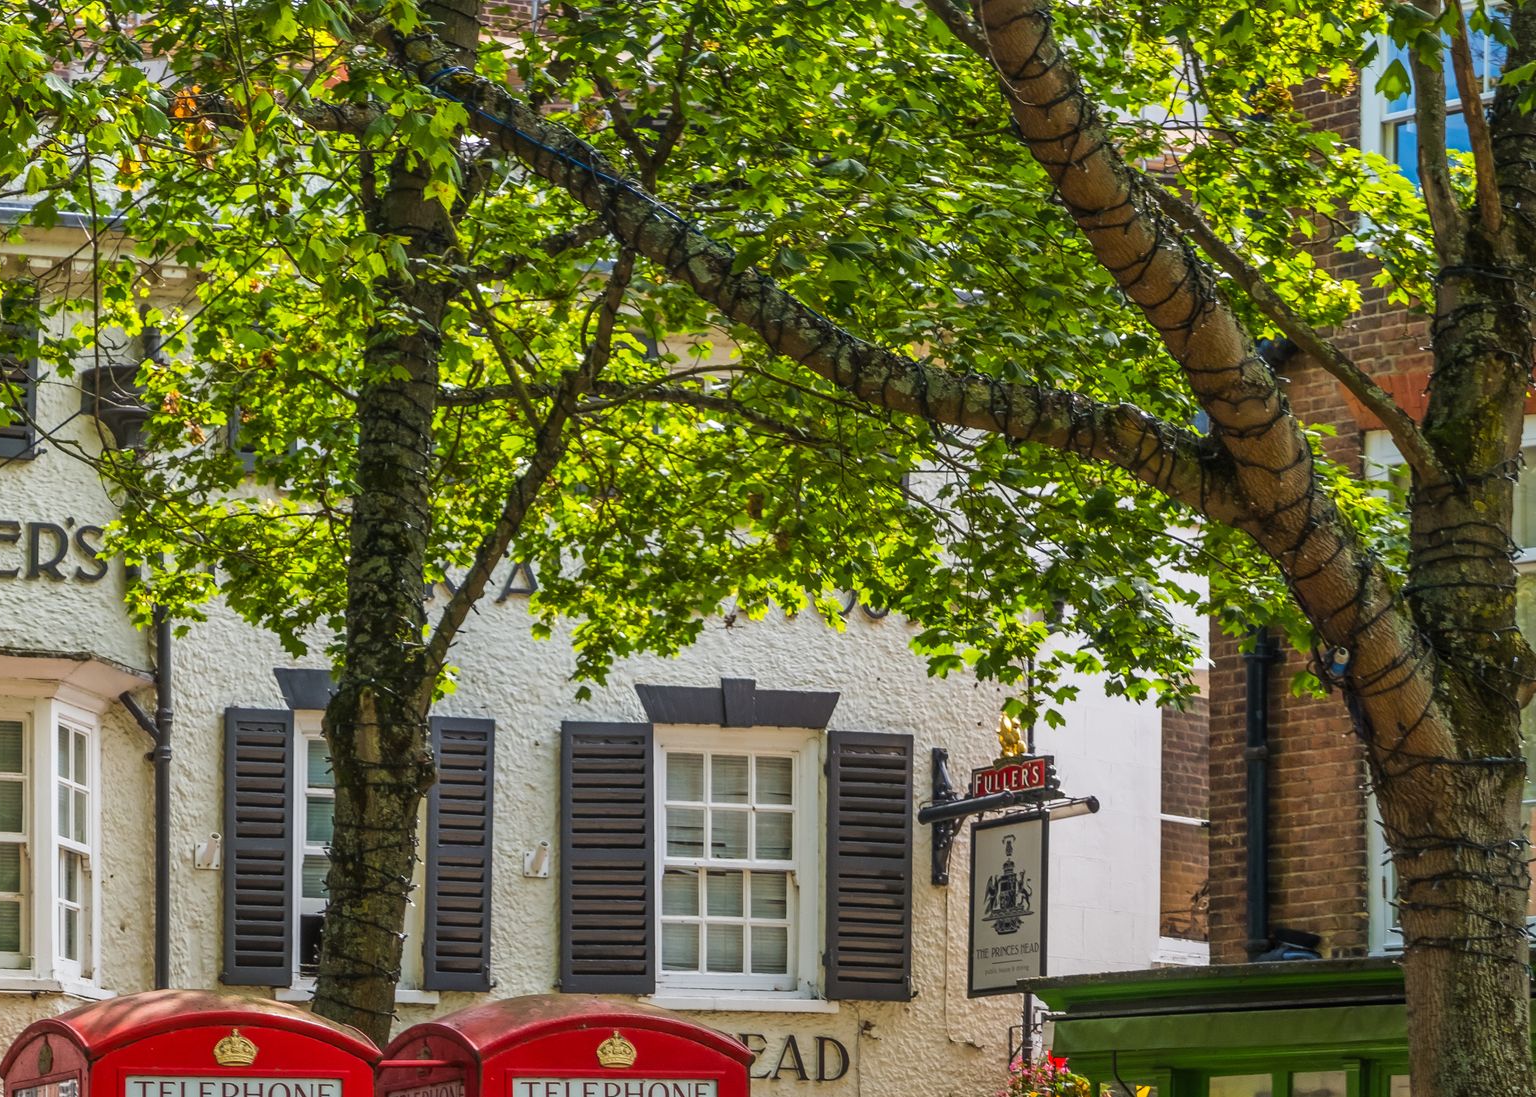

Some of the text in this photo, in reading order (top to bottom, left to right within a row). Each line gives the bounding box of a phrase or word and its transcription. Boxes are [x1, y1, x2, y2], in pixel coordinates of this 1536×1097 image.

[974, 762, 1040, 794] FULLER'S
[976, 942, 1040, 959] THE PRINCES HEAD
[738, 1033, 850, 1082] EAD
